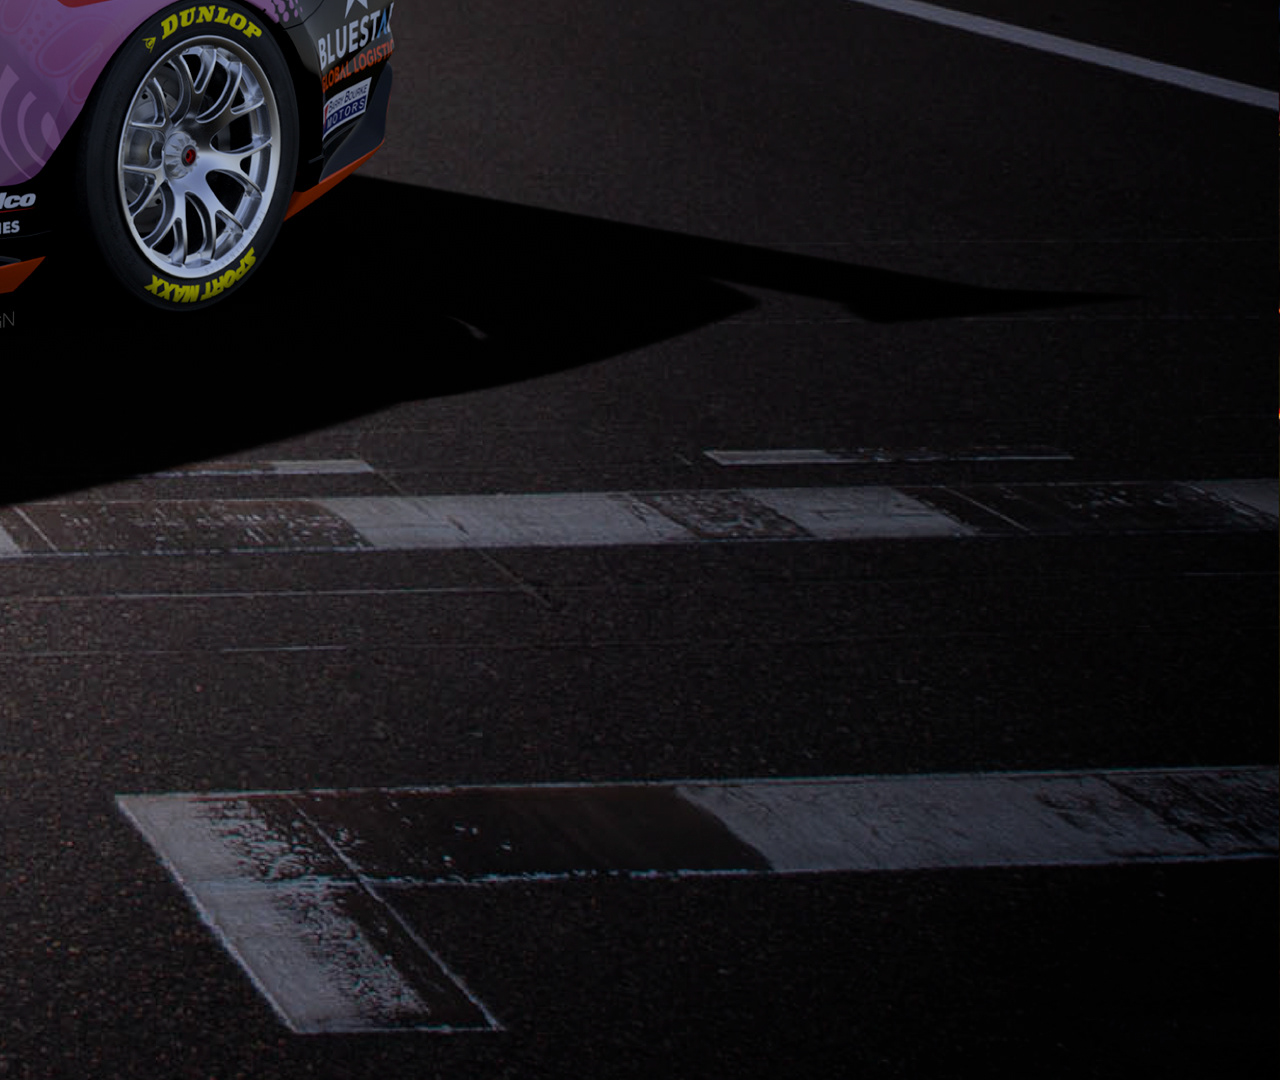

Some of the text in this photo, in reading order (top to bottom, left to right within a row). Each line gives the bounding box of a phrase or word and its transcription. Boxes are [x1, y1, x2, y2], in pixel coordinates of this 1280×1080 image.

[161, 5, 263, 40] DUNLOP
[326, 98, 366, 130] MOTORS
[143, 246, 257, 303] SPORT MAXX
